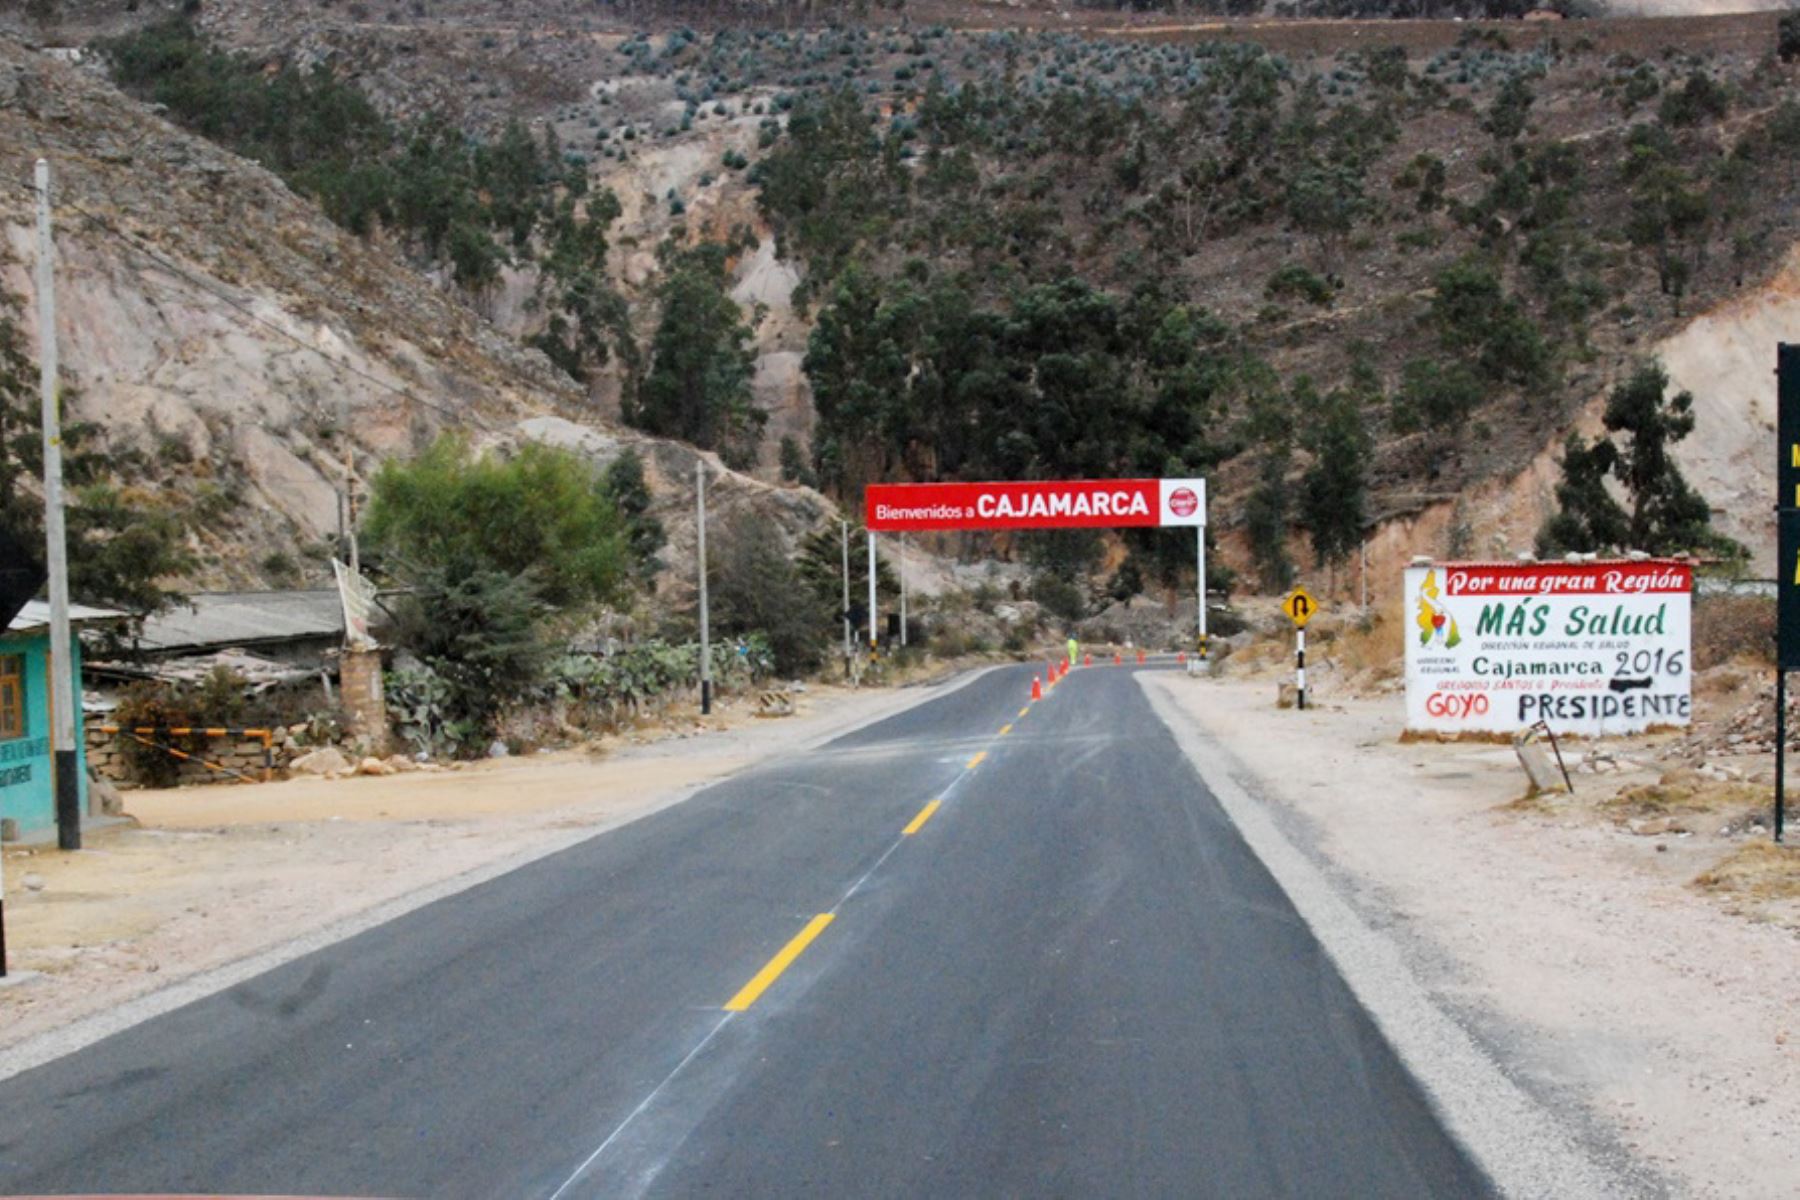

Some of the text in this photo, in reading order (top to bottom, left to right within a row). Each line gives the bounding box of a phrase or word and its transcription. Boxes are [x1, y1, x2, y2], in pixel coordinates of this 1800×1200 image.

[876, 491, 1149, 519] Bienvenidos a CAJAMARCA
[1448, 567, 1684, 595] Por una gran Región
[1476, 597, 1667, 636] MÁS Salud
[1583, 640, 1595, 650] DE
[1472, 656, 1604, 678] Cajamarca
[1614, 647, 1685, 677] 2016
[1426, 692, 1490, 719] GOYO
[1518, 693, 1691, 720] PRESIDENTE
